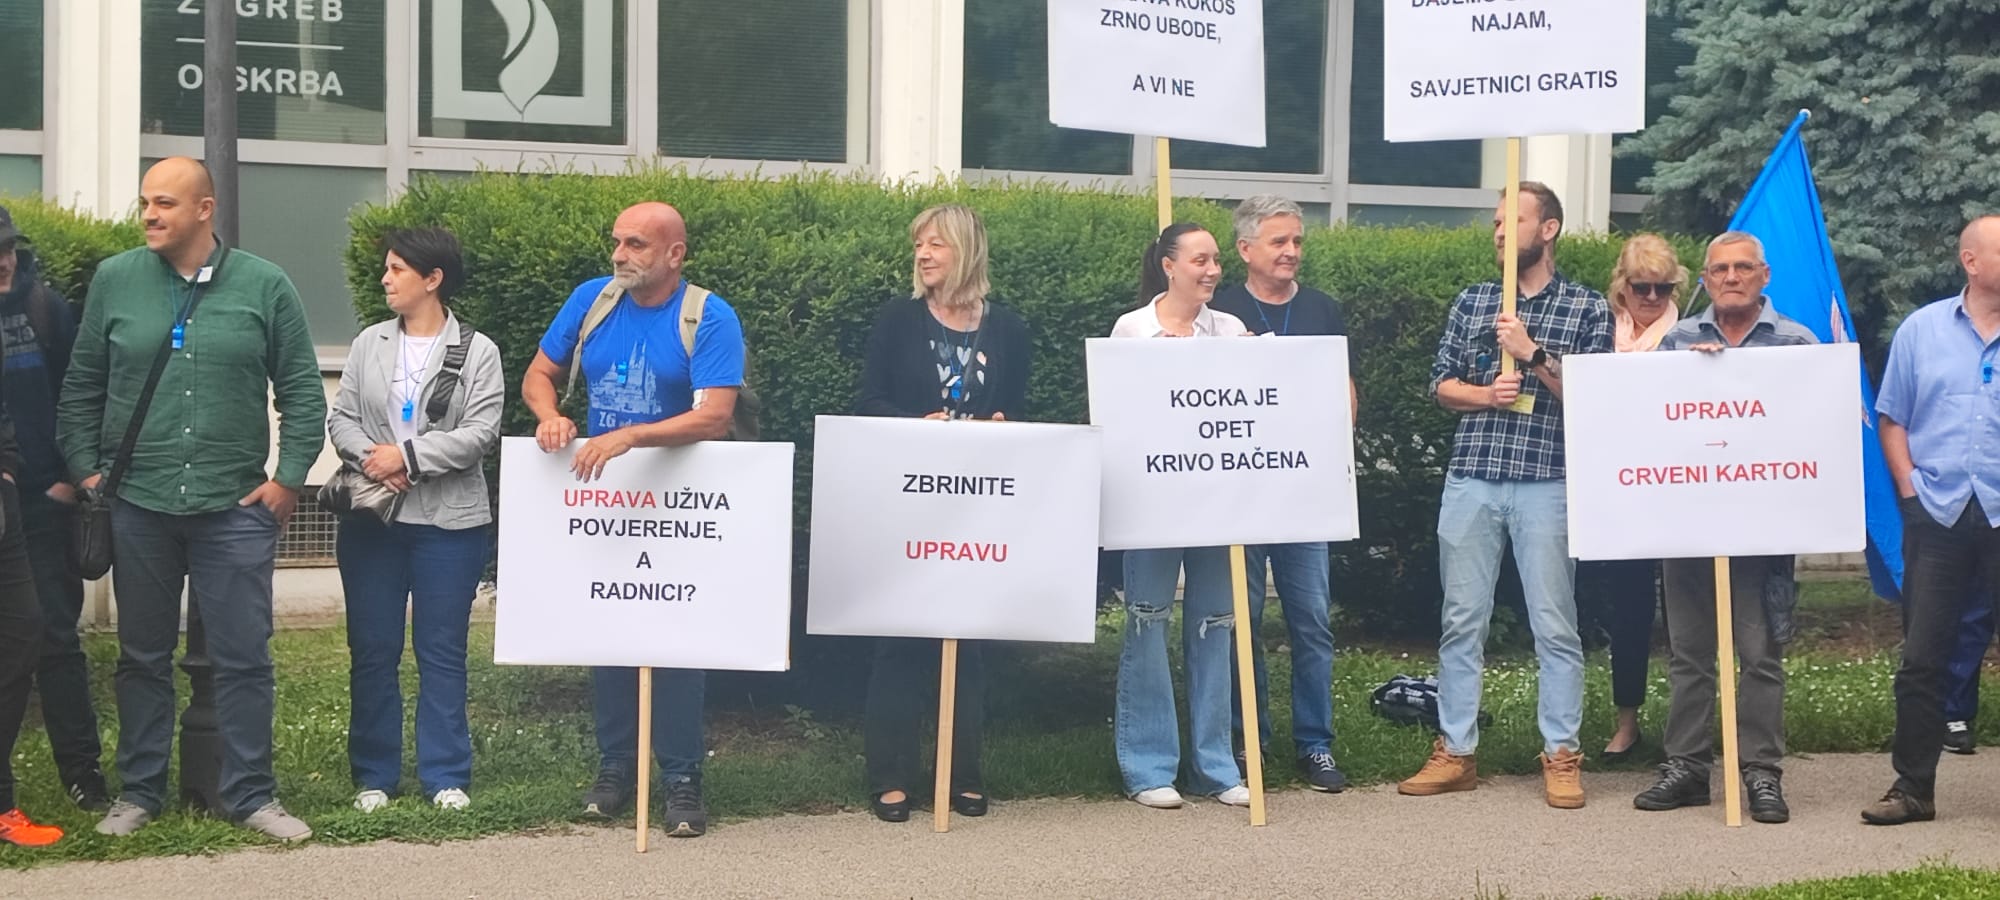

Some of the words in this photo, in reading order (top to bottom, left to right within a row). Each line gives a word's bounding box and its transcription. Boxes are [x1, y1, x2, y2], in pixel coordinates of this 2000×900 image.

[176, 0, 343, 22] ZGREB
[1471, 10, 1552, 33] NAJAM,
[1100, 8, 1151, 32] ZRNO
[1156, 15, 1221, 44] UBODE,
[178, 63, 344, 96] OSKRBA
[1132, 74, 1146, 92] A
[1149, 75, 1166, 95] VI
[1171, 78, 1195, 98] NE
[1410, 74, 1531, 99] SAVJETNICI
[1537, 69, 1618, 92] GRATIS
[1170, 388, 1249, 408] KOCKA
[1253, 387, 1279, 407] JE
[1665, 399, 1766, 421] UPRAVA
[1198, 419, 1256, 440] OPET
[1146, 452, 1215, 473] KRIVO
[1220, 446, 1310, 471] BAČENA
[902, 473, 1015, 497] ZBRINITE
[1618, 465, 1708, 486] CRVENI
[1716, 460, 1818, 483] KARTON
[564, 488, 657, 509] UPRAVA
[663, 486, 731, 511] UŽIVA
[568, 517, 722, 542] POVJERENJE,
[635, 551, 652, 569] A
[905, 540, 1008, 563] UPRAVU
[590, 581, 697, 602] RADNICI?
